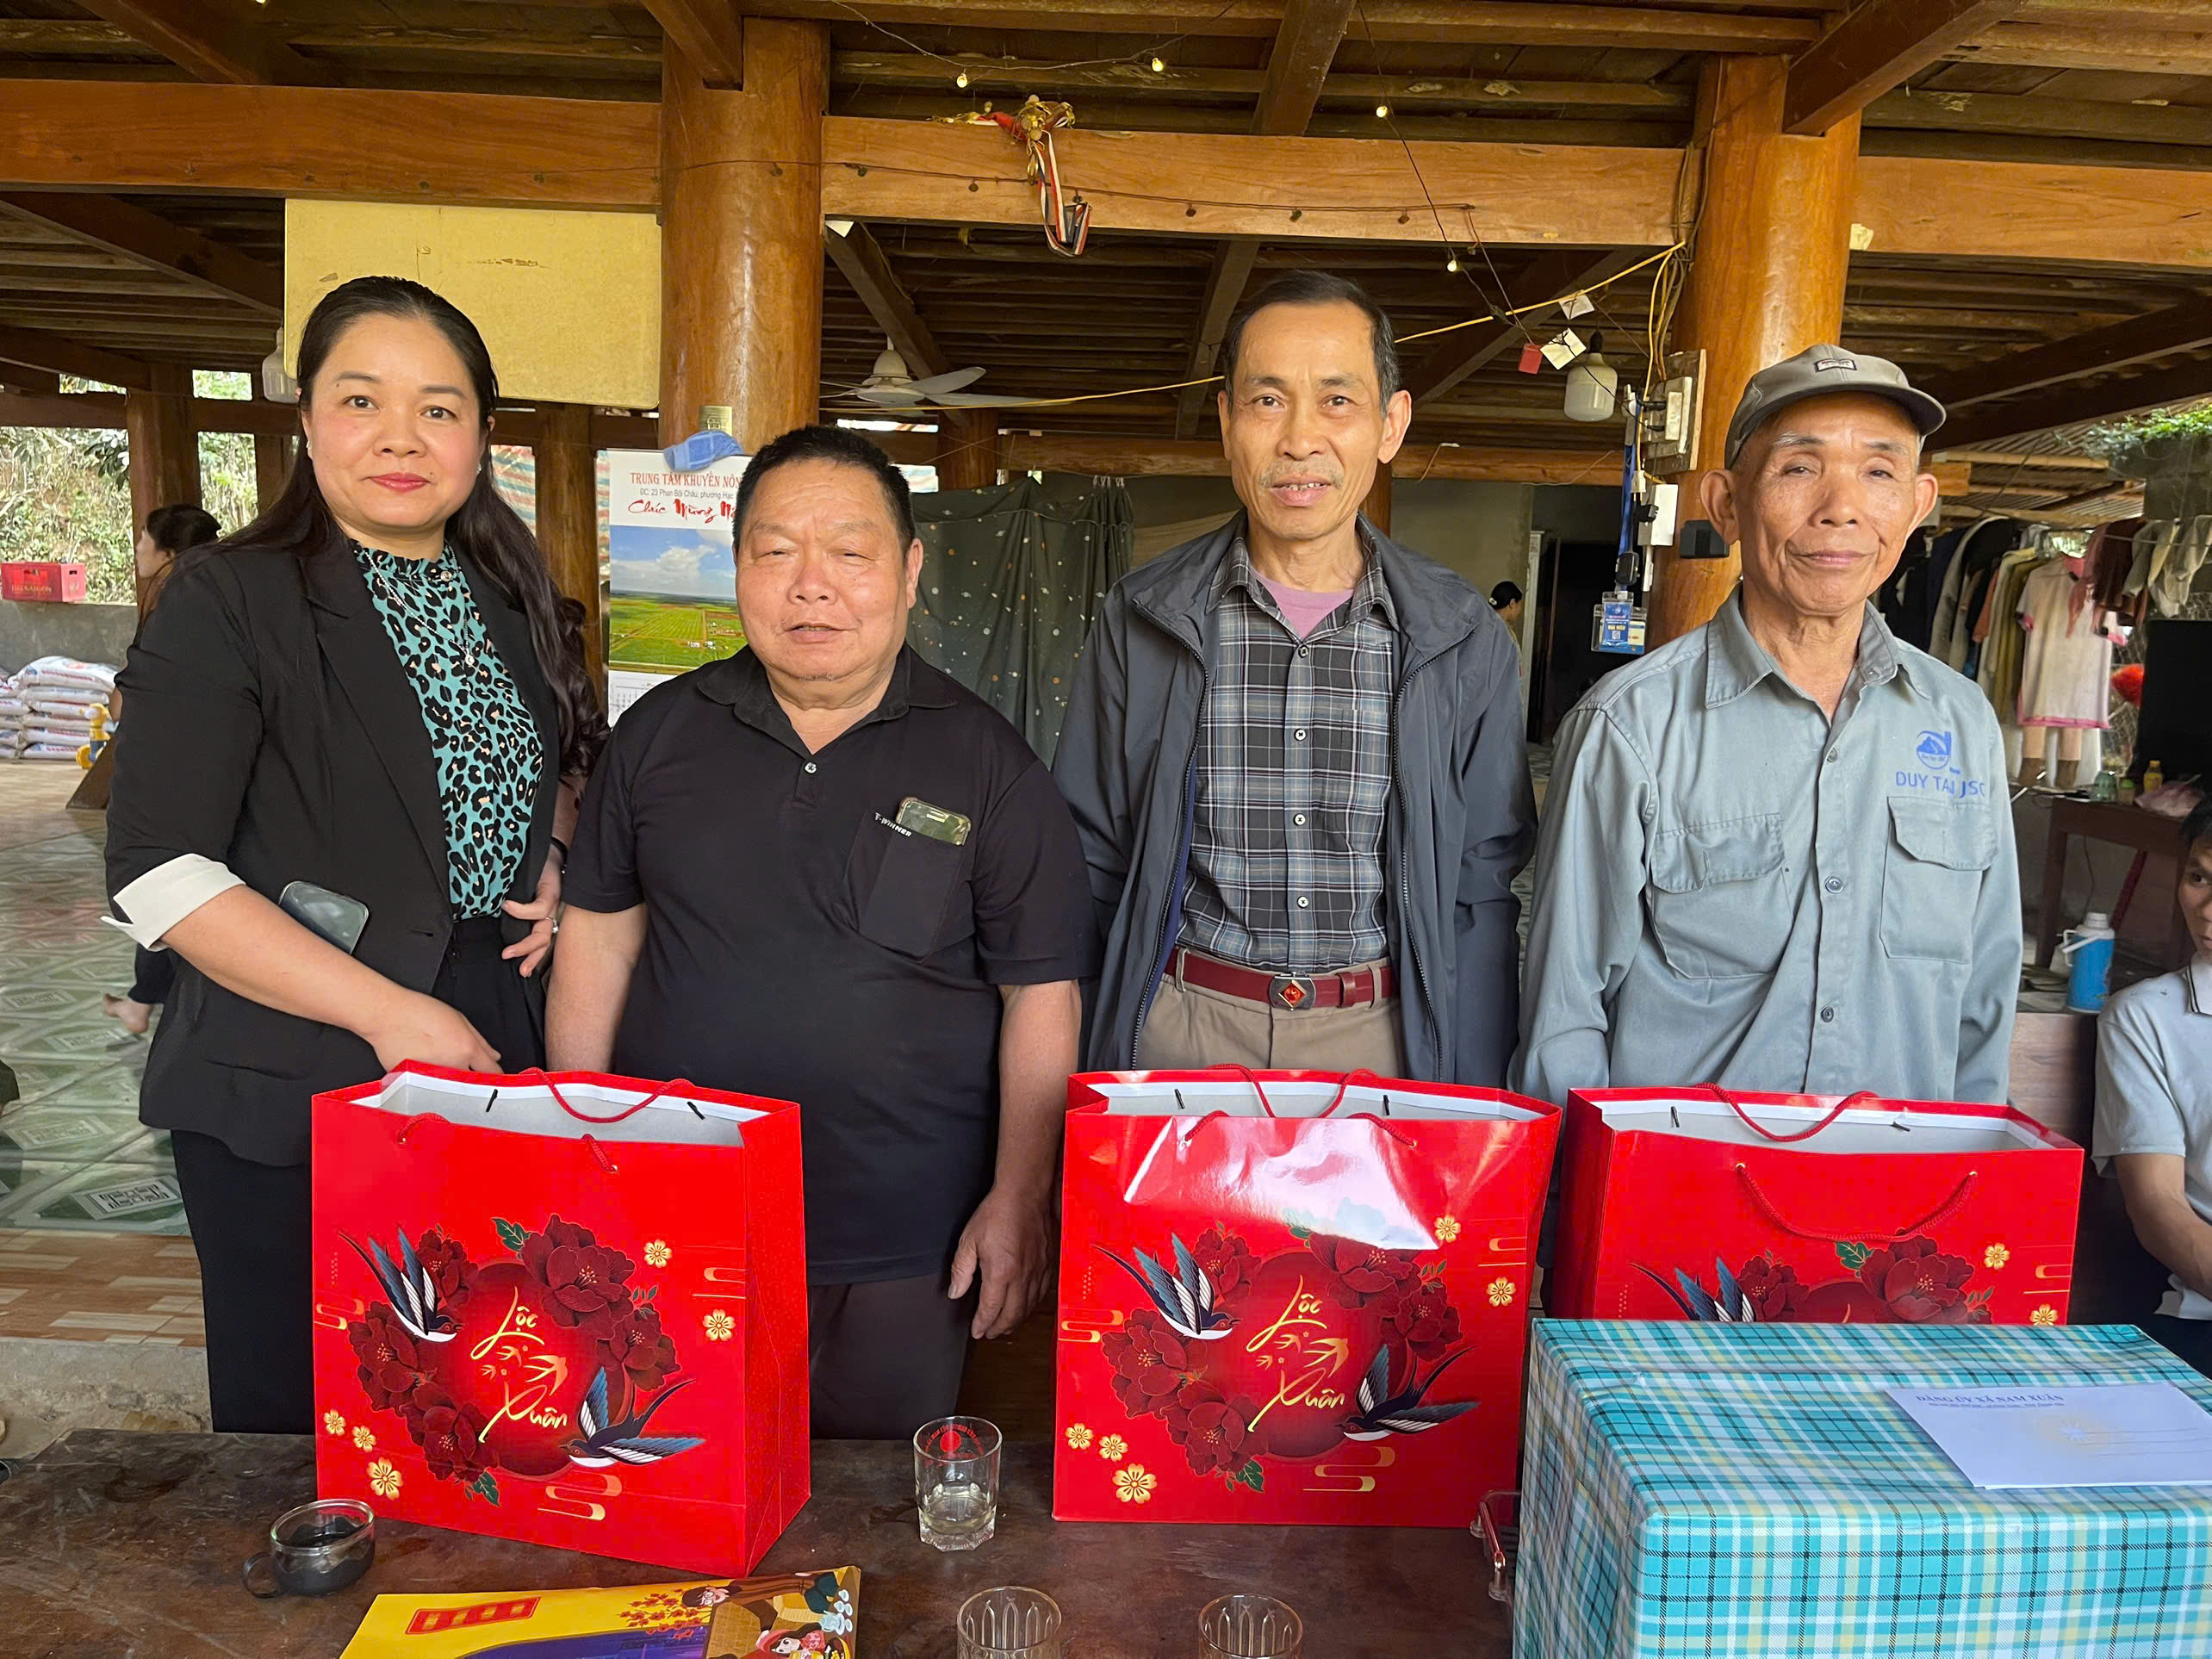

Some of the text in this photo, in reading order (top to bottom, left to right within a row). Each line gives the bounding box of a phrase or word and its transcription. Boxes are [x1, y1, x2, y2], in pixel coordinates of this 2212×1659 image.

[630, 472, 660, 485] TRUNG
[683, 470, 720, 488] KHUYẾN
[722, 473, 742, 488] NÔN
[659, 488, 673, 497] Phan
[628, 500, 668, 513] Chúc
[1895, 771, 1929, 789] DUY
[1246, 1274, 1327, 1352] Lộc
[470, 1286, 545, 1360] Lộc
[1247, 1367, 1345, 1432] Xuân
[1995, 1395, 2027, 1403] NAM
[478, 1381, 568, 1444] Xuân
